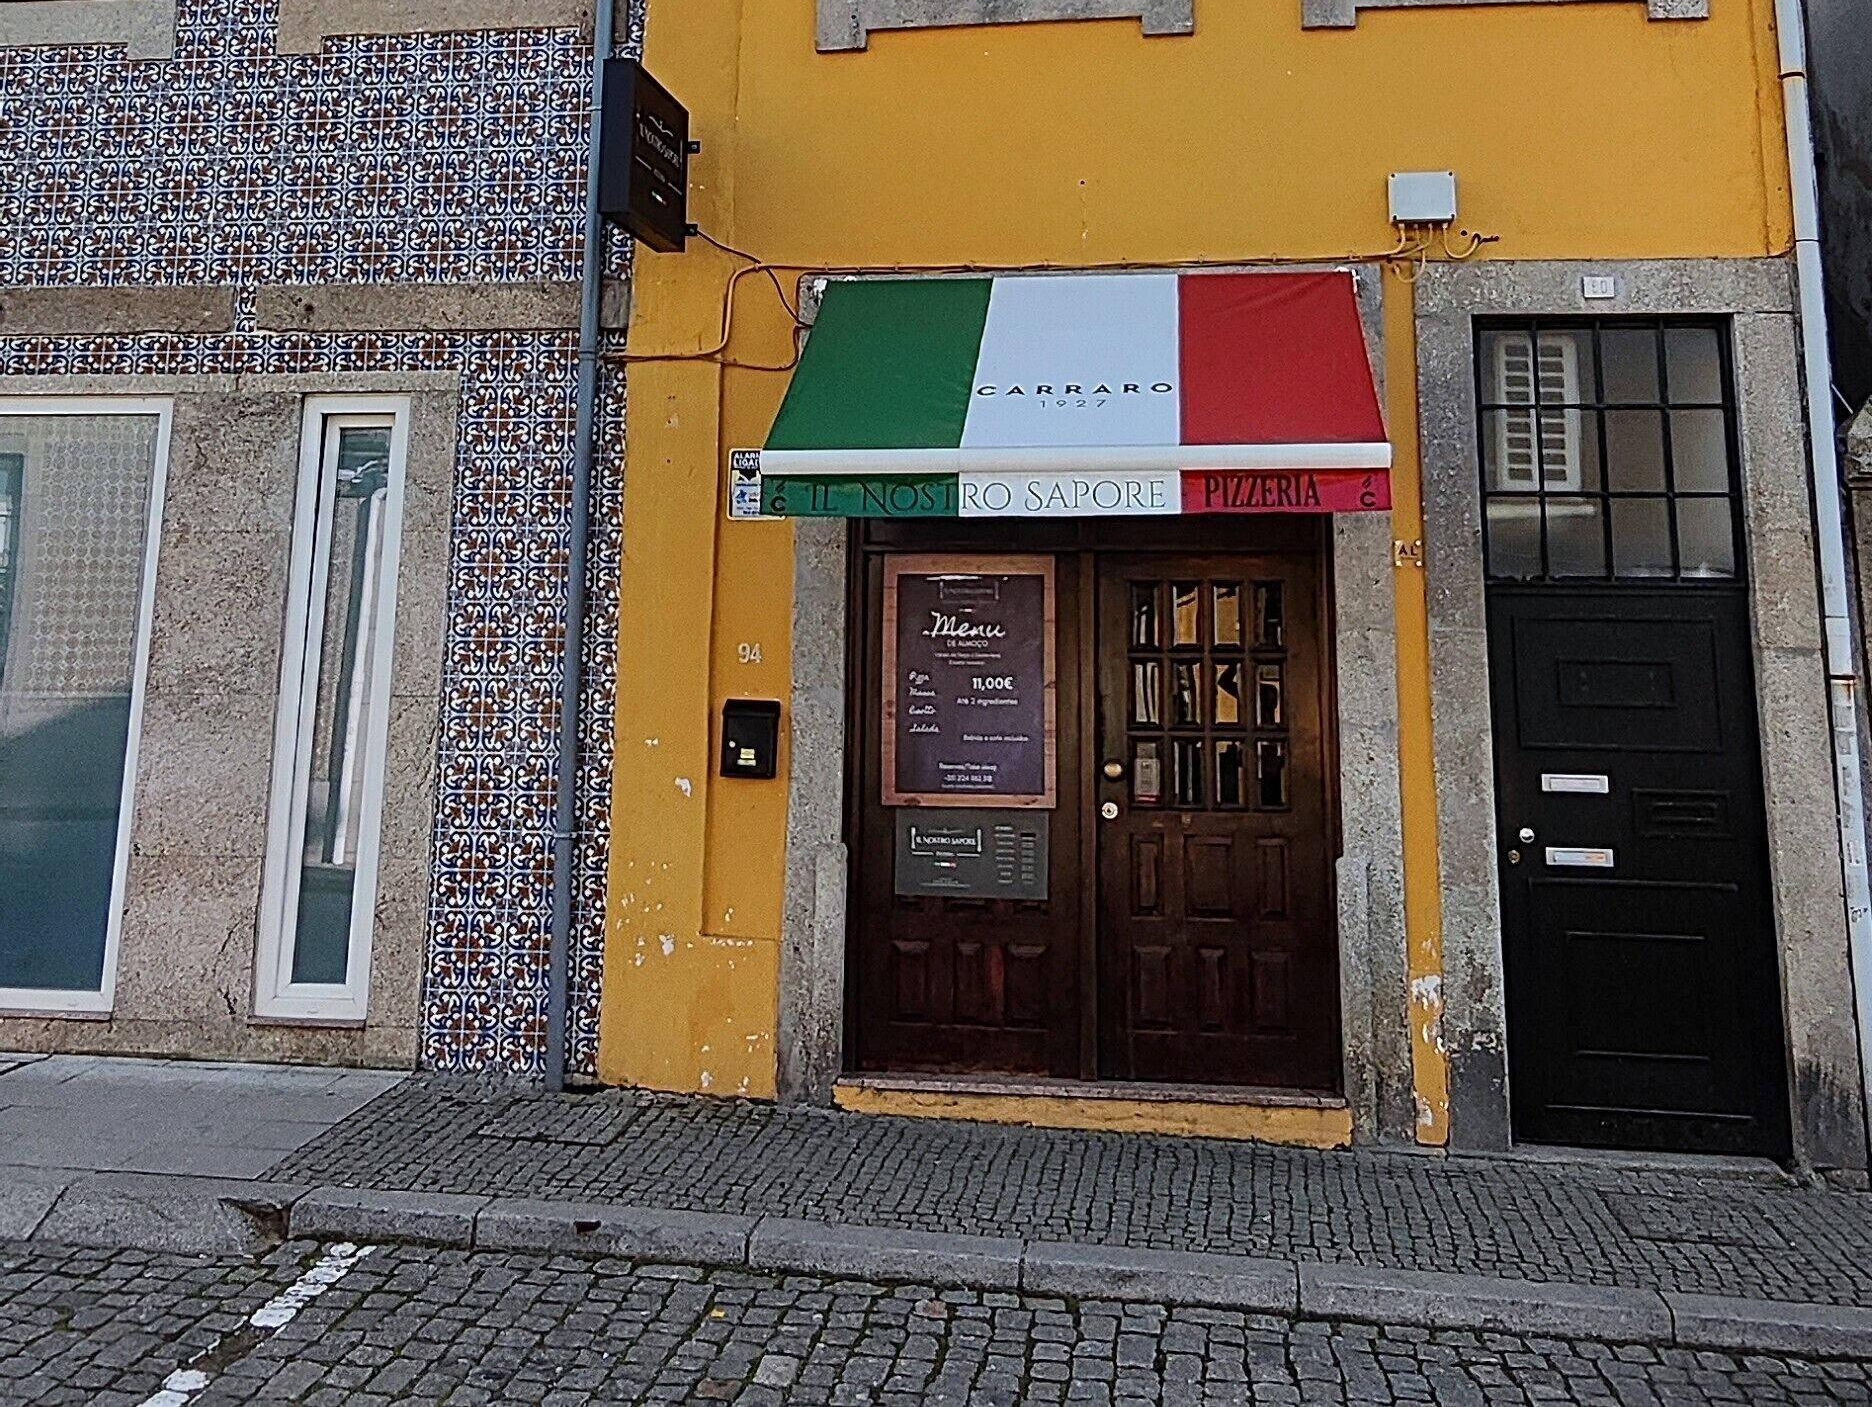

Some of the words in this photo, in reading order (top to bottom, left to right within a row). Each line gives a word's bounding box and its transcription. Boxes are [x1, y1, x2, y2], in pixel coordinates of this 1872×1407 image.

[976, 382, 1173, 396] CARRARO
[1039, 399, 1106, 408] 1927
[810, 483, 839, 512] IL
[859, 480, 1011, 515] NOSTRO
[1024, 479, 1167, 512] SAPORE
[1205, 473, 1322, 508] PIZZERIA
[922, 610, 1006, 638] Menu
[737, 643, 762, 663] 94
[971, 676, 1014, 691] 11,00€
